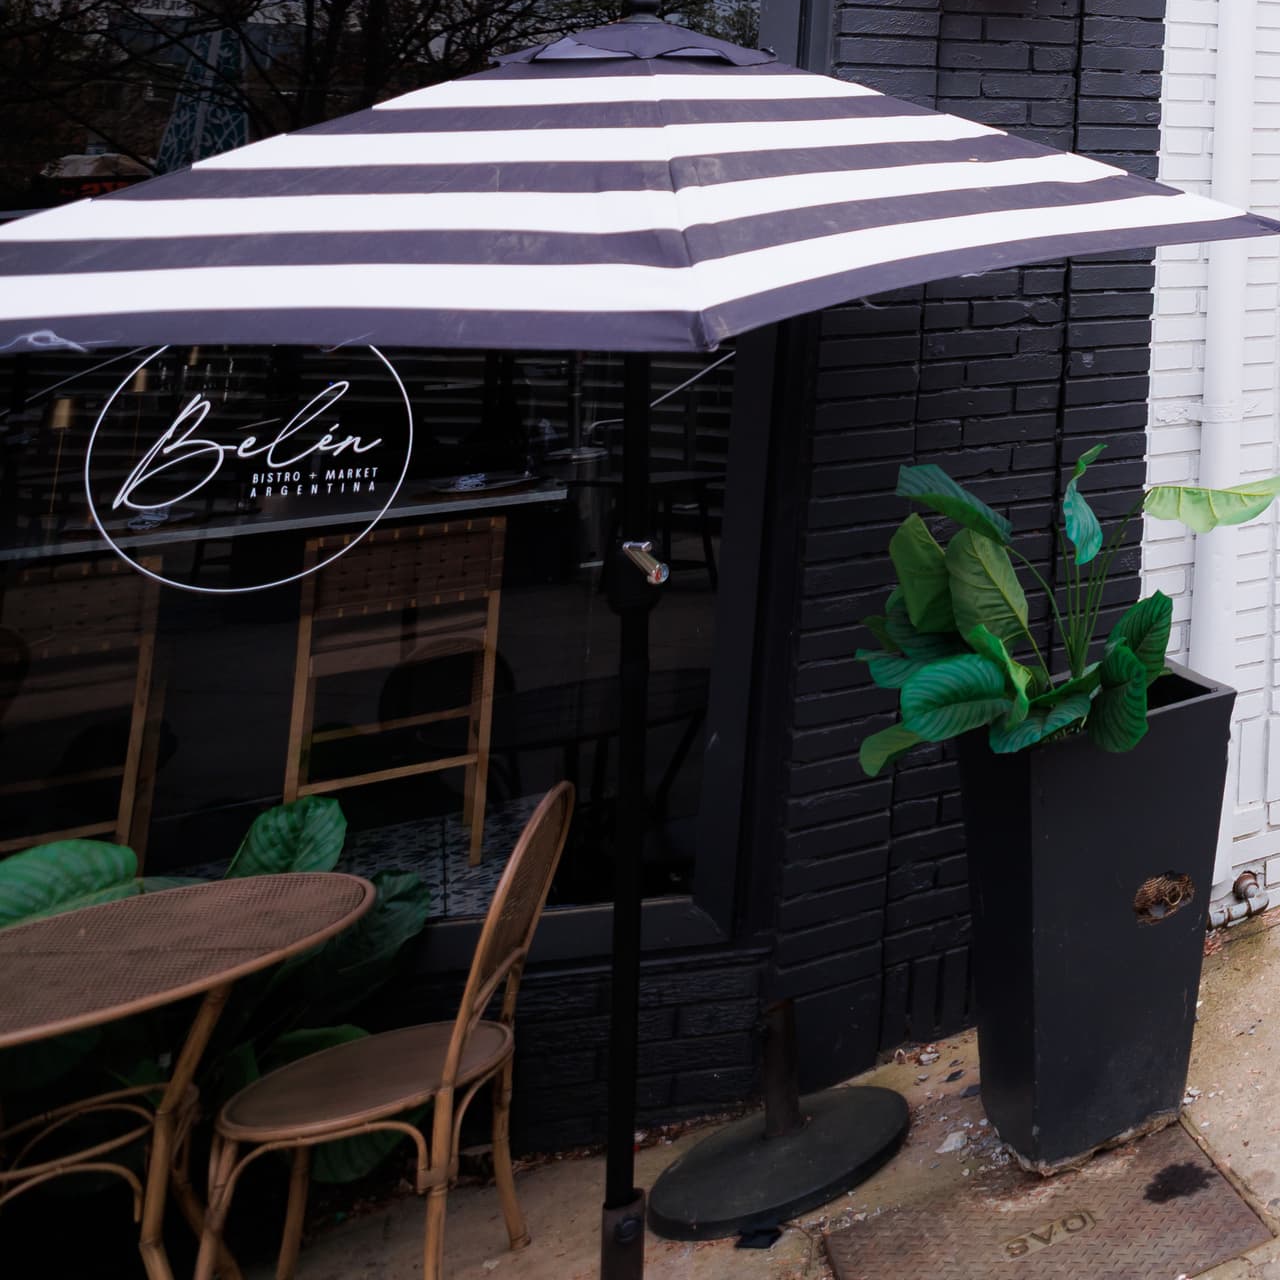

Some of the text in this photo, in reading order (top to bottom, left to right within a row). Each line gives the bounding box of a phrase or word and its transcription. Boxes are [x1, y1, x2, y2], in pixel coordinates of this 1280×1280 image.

[112, 380, 382, 510] Belén
[252, 471, 300, 484] BISTRO
[325, 467, 378, 480] MARKET
[250, 480, 375, 498] ARGENTINA
